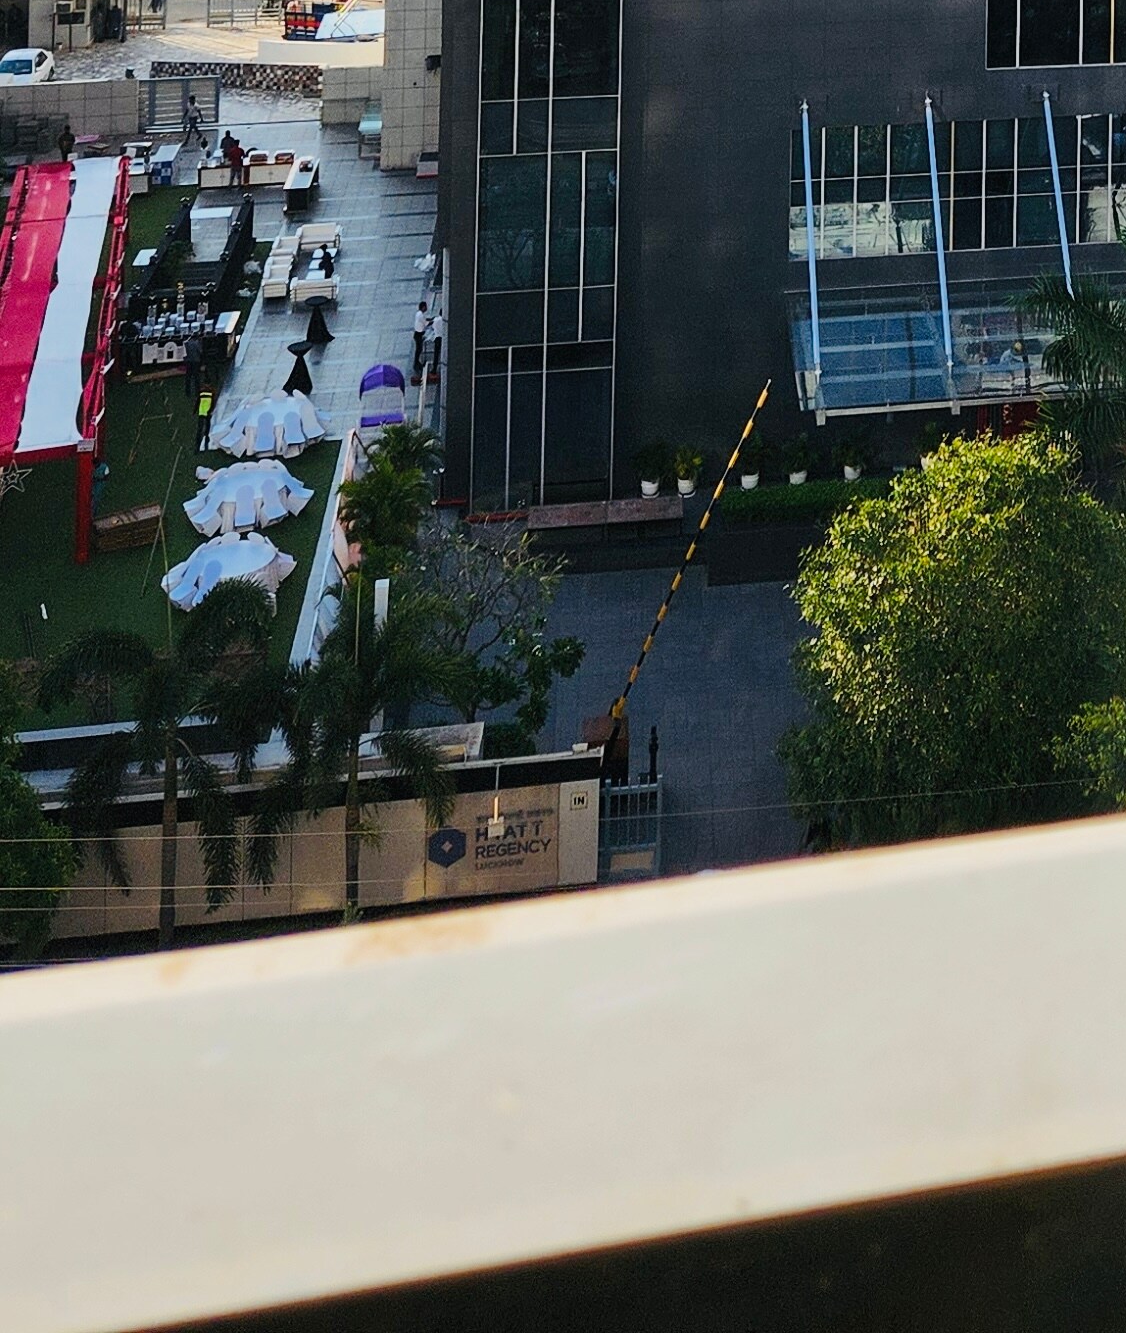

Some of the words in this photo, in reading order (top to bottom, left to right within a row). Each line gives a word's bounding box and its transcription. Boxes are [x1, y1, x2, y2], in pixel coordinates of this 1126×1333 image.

[573, 796, 585, 806] IN
[475, 820, 543, 843] HATT
[475, 838, 552, 860] REGENCY
